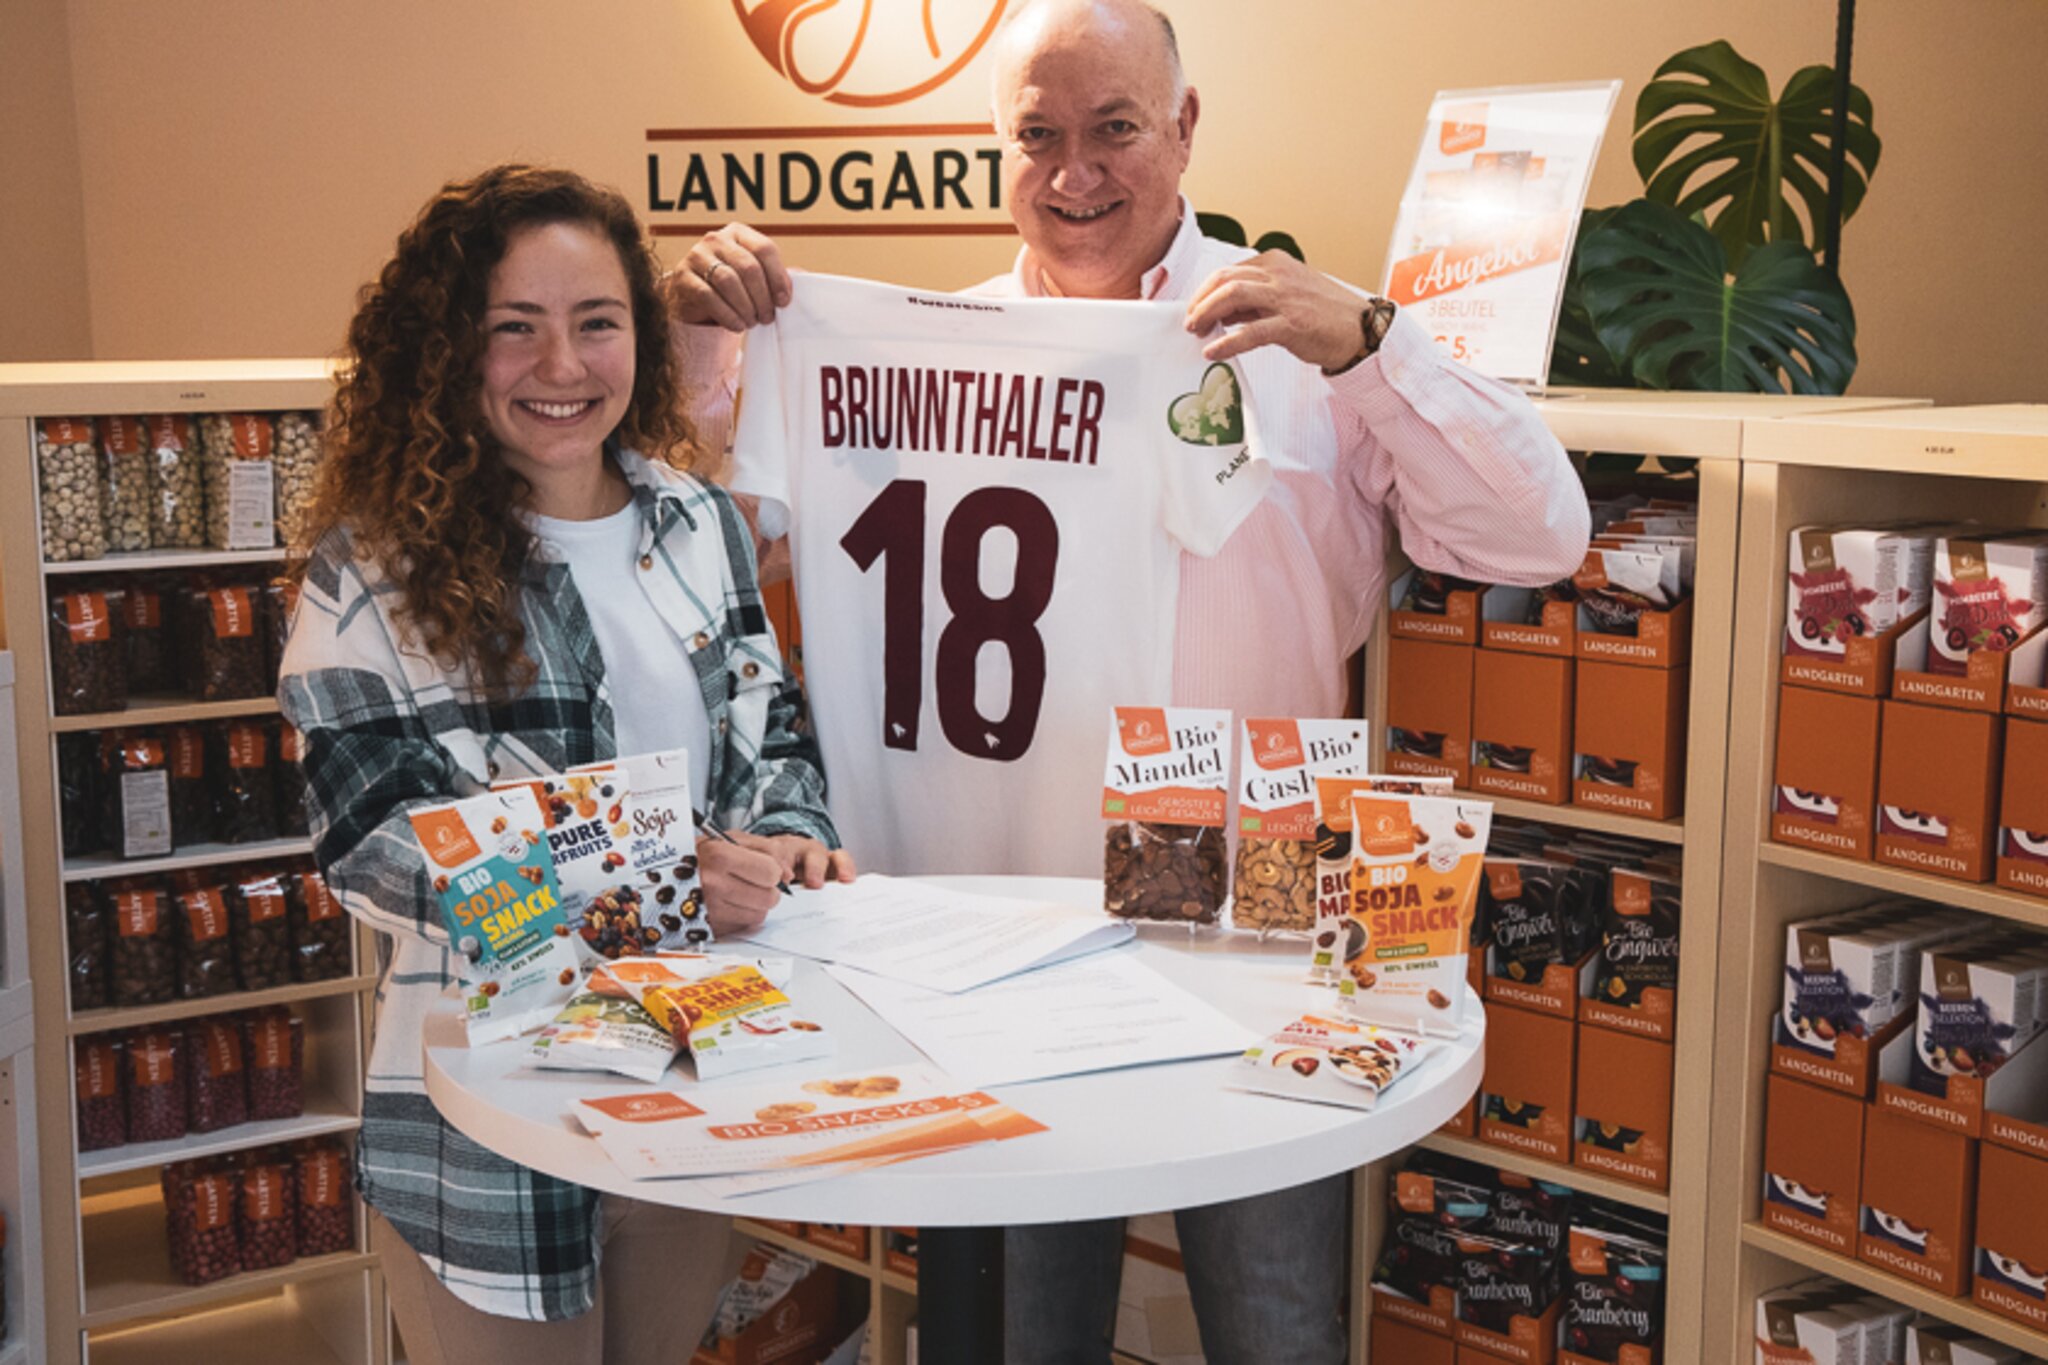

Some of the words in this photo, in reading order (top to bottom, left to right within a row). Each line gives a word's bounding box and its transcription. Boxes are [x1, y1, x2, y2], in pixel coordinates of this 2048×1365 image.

[821, 365, 1105, 465] BRUNNTHALER
[839, 479, 1059, 762] 18
[1397, 620, 1464, 637] LANDGARTEN
[1490, 629, 1560, 647] LANDGARTEN
[1583, 640, 1657, 659] LANDGARTEN
[1787, 665, 1864, 687] LANDGARTEN
[1900, 681, 1986, 701] LANDGARTEN
[1175, 726, 1218, 750] Bio
[1309, 737, 1352, 762] Bio
[1115, 748, 1223, 787] Mandel
[1479, 774, 1548, 796] LANDGARTEN
[1581, 789, 1652, 812] LANDGARTEN
[547, 818, 607, 852] PURE
[633, 806, 678, 839] Soja
[1780, 822, 1857, 849] LANDGARTEN
[1885, 845, 1968, 872] LANDGARTEN
[457, 867, 493, 896] BIO
[1371, 865, 1407, 886] BIO
[453, 880, 519, 928] SOJA
[1355, 884, 1422, 913] SOJA
[480, 885, 559, 943] SNACK
[1372, 905, 1459, 937] SNACK
[1780, 1056, 1854, 1087] LANDGARTEN
[722, 1122, 788, 1139] BIO
[796, 1100, 941, 1130] SNACKS
[1885, 1093, 1968, 1127] LANDGARTEN
[1488, 1128, 1557, 1155] LANDGARTEN
[1583, 1151, 1656, 1181] LANDGARTEN
[1772, 1211, 1847, 1248] LANDGARTEN
[1866, 1244, 1945, 1284] LANDGARTEN
